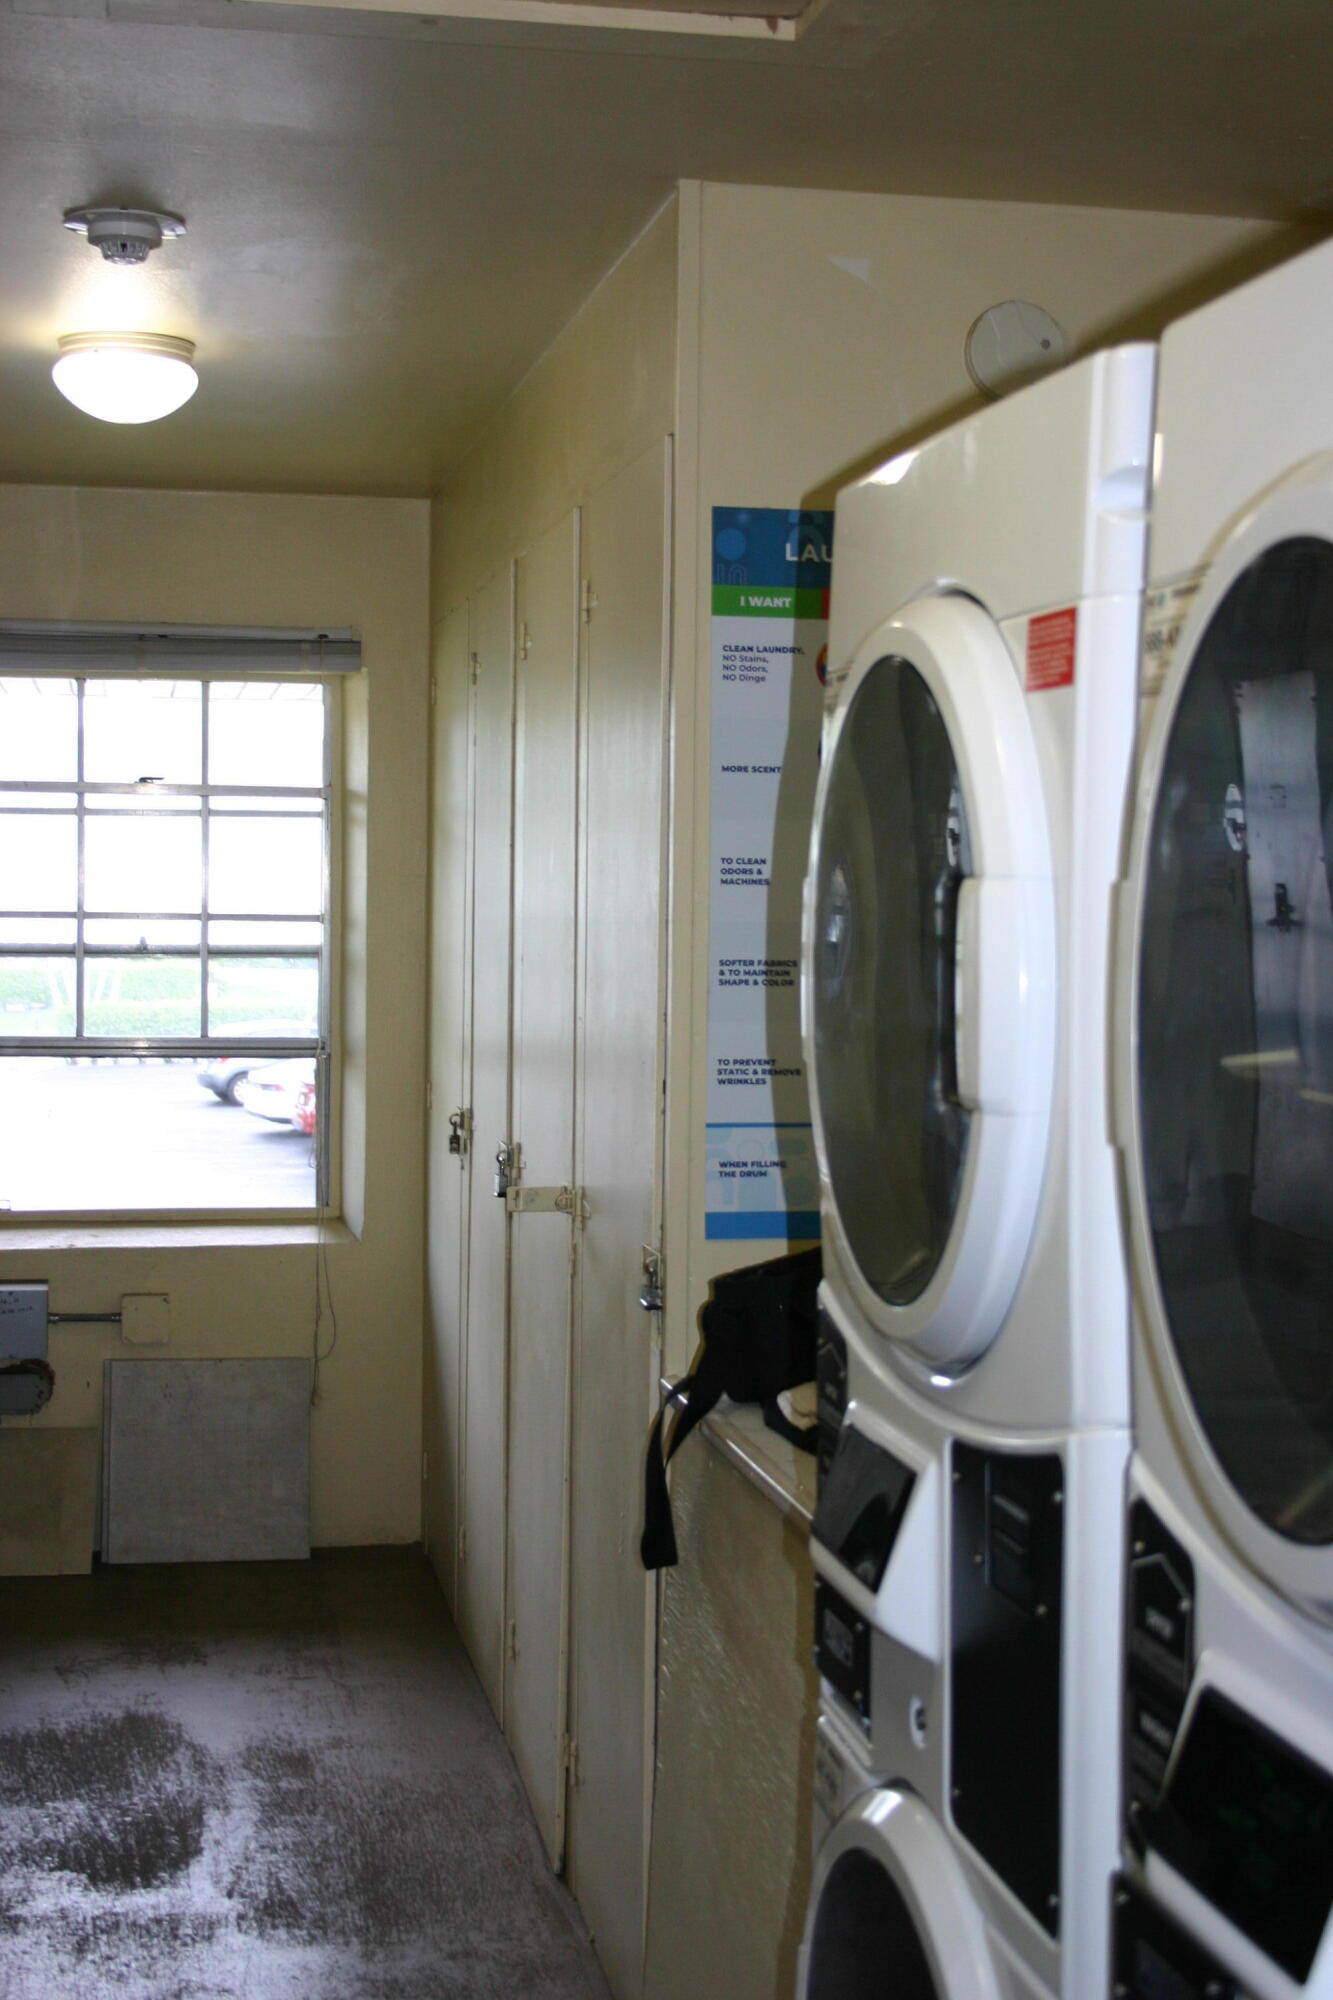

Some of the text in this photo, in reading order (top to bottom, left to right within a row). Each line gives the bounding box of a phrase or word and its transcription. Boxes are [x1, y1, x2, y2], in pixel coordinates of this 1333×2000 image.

[740, 596, 792, 607] I WANT
[739, 654, 768, 663] Stains,
[739, 665, 768, 673] Odors,
[739, 674, 766, 682] Dinge
